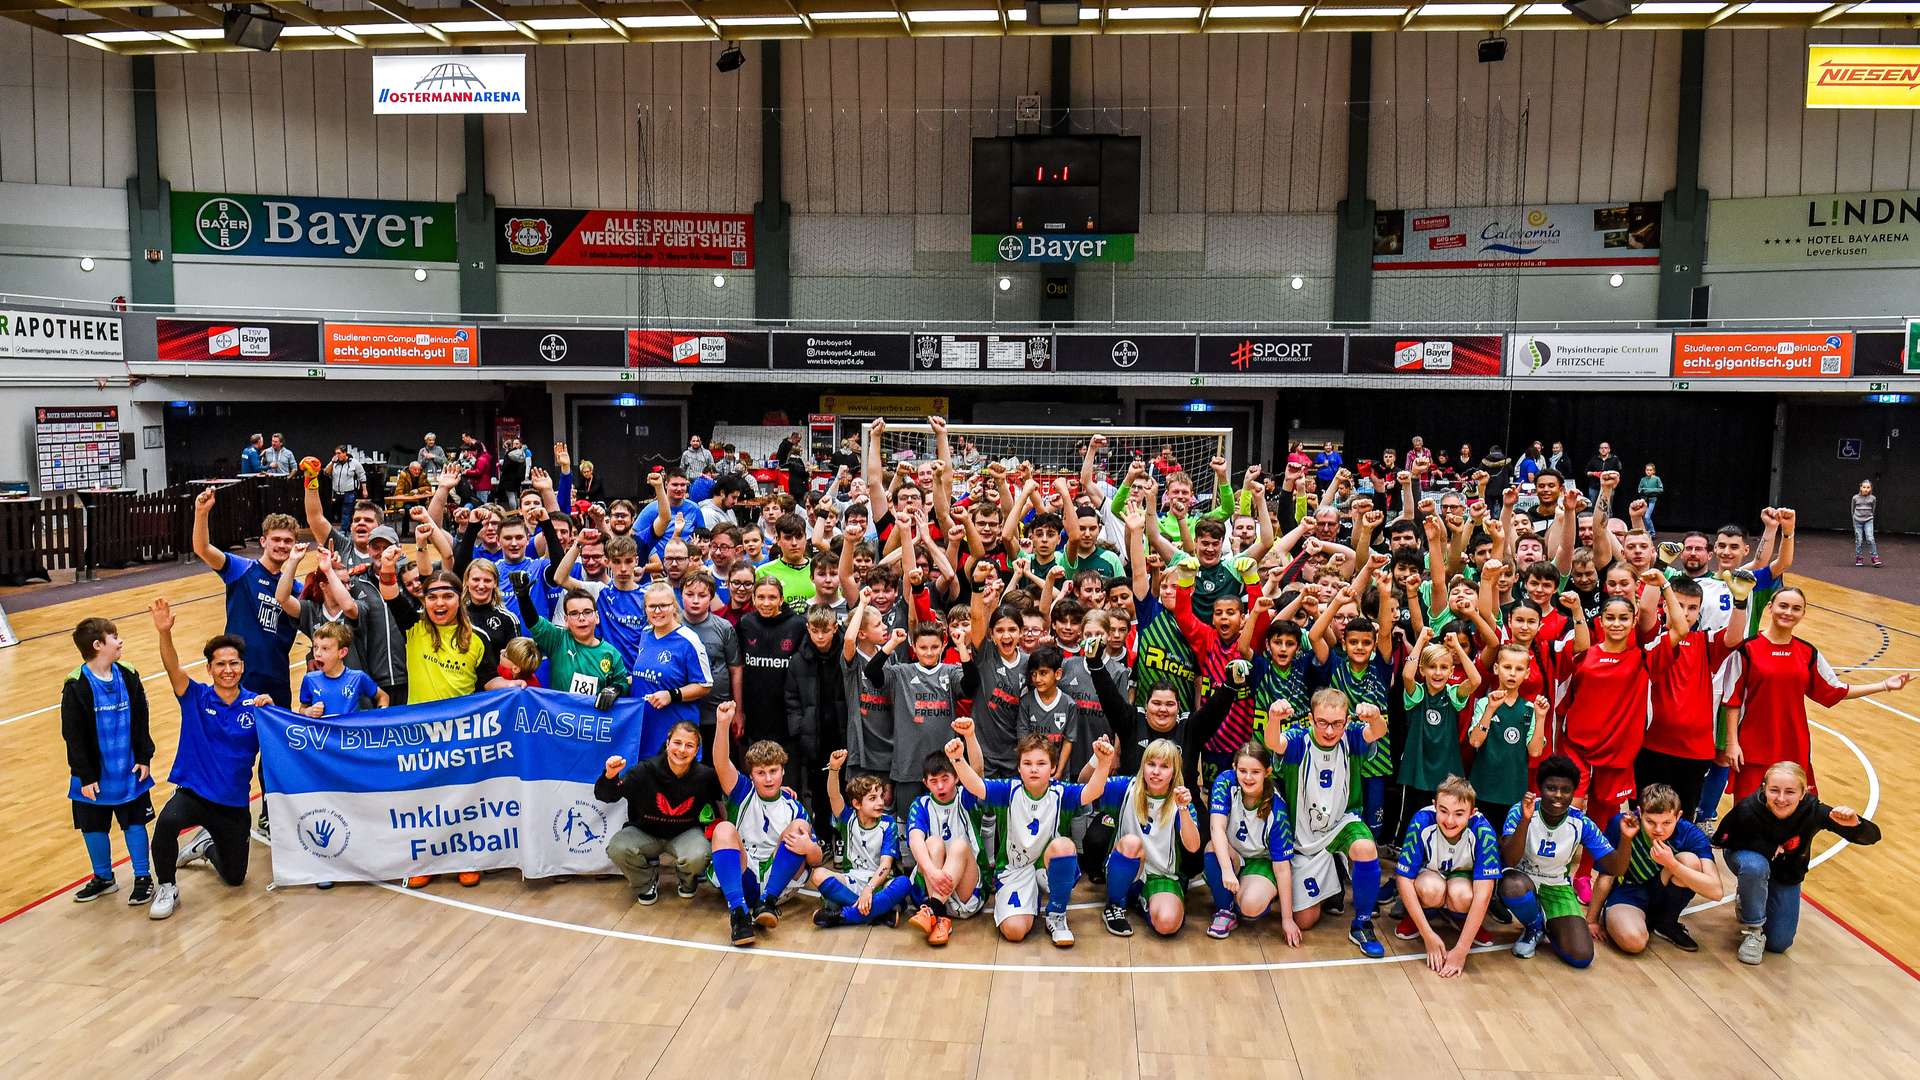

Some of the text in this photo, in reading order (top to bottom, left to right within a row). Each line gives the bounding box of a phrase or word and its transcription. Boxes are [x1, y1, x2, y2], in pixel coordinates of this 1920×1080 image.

[1817, 68, 1920, 87] NIESEN
[201, 219, 248, 230] BAYER
[263, 201, 434, 254] Bayer
[605, 218, 746, 235] ALLES RUND UM DIE
[580, 231, 746, 248] WERKSELF GIBT'S HIER
[1807, 233, 1909, 245] HOTEL BAYARENA
[1028, 236, 1107, 261] Bayer
[1806, 247, 1867, 257] Leverkusen
[1046, 282, 1068, 295] Ost
[14, 316, 120, 341] APOTHEKE
[241, 334, 268, 343] Bayer
[333, 333, 371, 342] Studieren
[333, 346, 446, 360] echt.gigantisch.gut!
[701, 342, 725, 352] Bayer
[1425, 348, 1451, 357] Bayer
[1556, 345, 1659, 355] Physiotherapie Centrum
[1684, 343, 1726, 353] Studieren
[1556, 357, 1605, 367] FRITZSCHE
[1683, 357, 1812, 370] echt.gigantisch.gut!
[847, 404, 921, 413] www.lagerbox.com
[1891, 428, 1900, 438] 8
[573, 679, 594, 695] 1&1
[915, 692, 938, 700] DEIN
[285, 724, 331, 750] SV
[514, 706, 613, 743] AASEE
[397, 741, 514, 772] MÜNSTER
[1320, 769, 1333, 789] 9
[389, 797, 521, 829] Inklusive
[942, 822, 952, 841] 3
[410, 827, 520, 861] Fußball
[1537, 839, 1557, 858] 12
[1303, 876, 1321, 898] 9
[1007, 891, 1022, 908] 4
